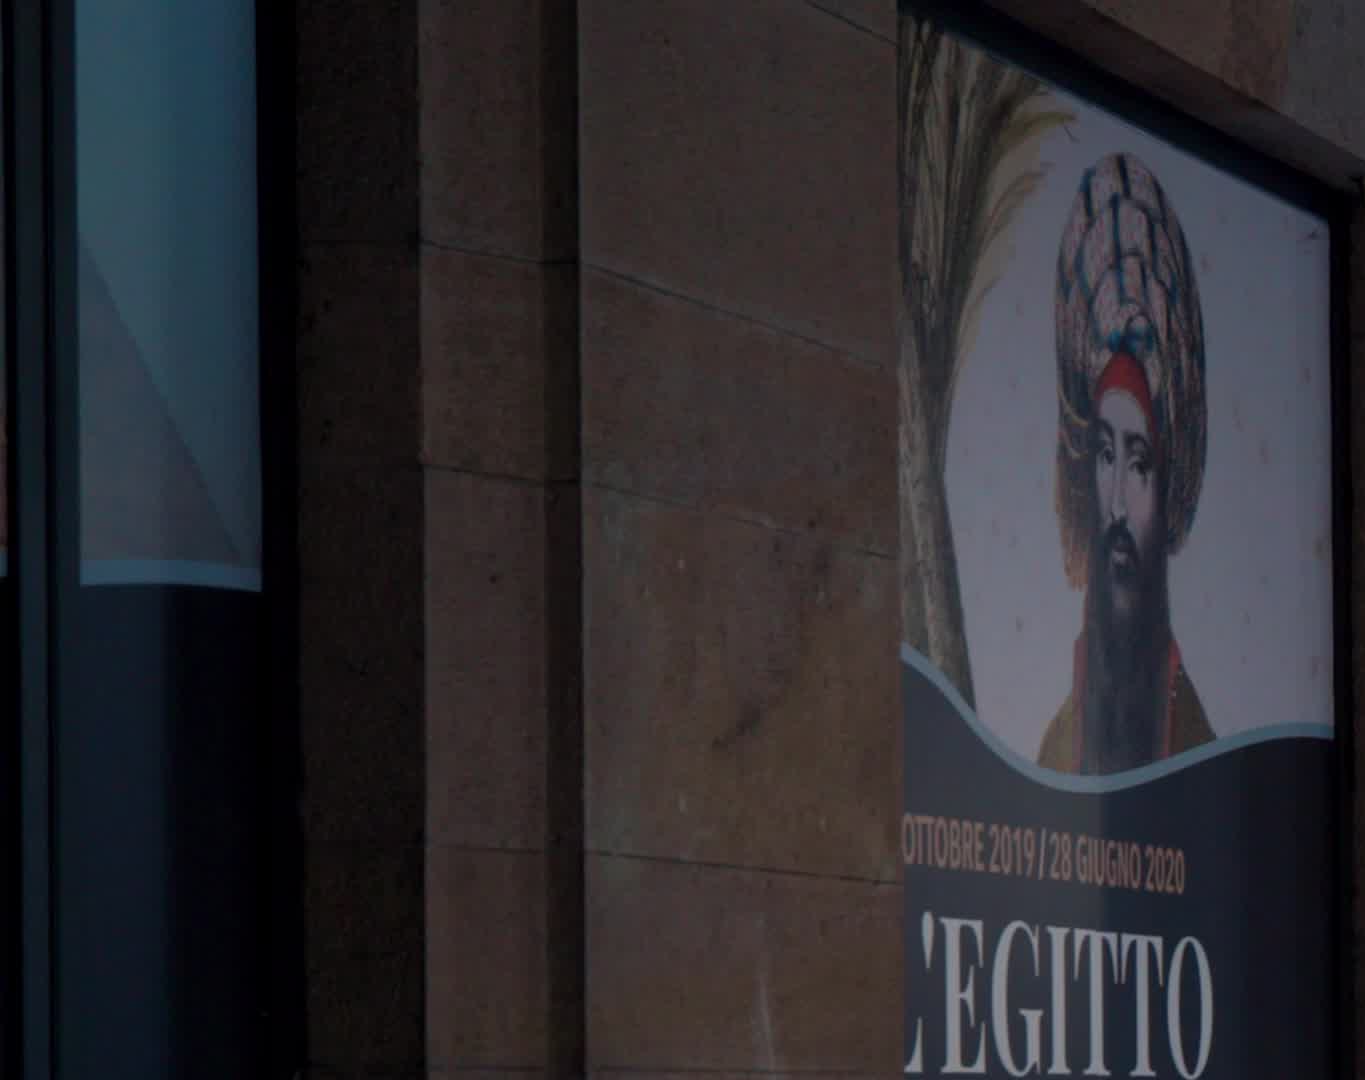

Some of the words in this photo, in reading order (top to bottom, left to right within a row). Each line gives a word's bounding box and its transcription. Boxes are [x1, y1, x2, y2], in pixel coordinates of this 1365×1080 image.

[903, 813, 985, 873] OTTOBRE
[989, 824, 1036, 880] 2019
[1038, 826, 1047, 881] /
[1050, 831, 1073, 882] 28
[1076, 834, 1141, 891] GIUGNO
[1145, 843, 1185, 895] 2020
